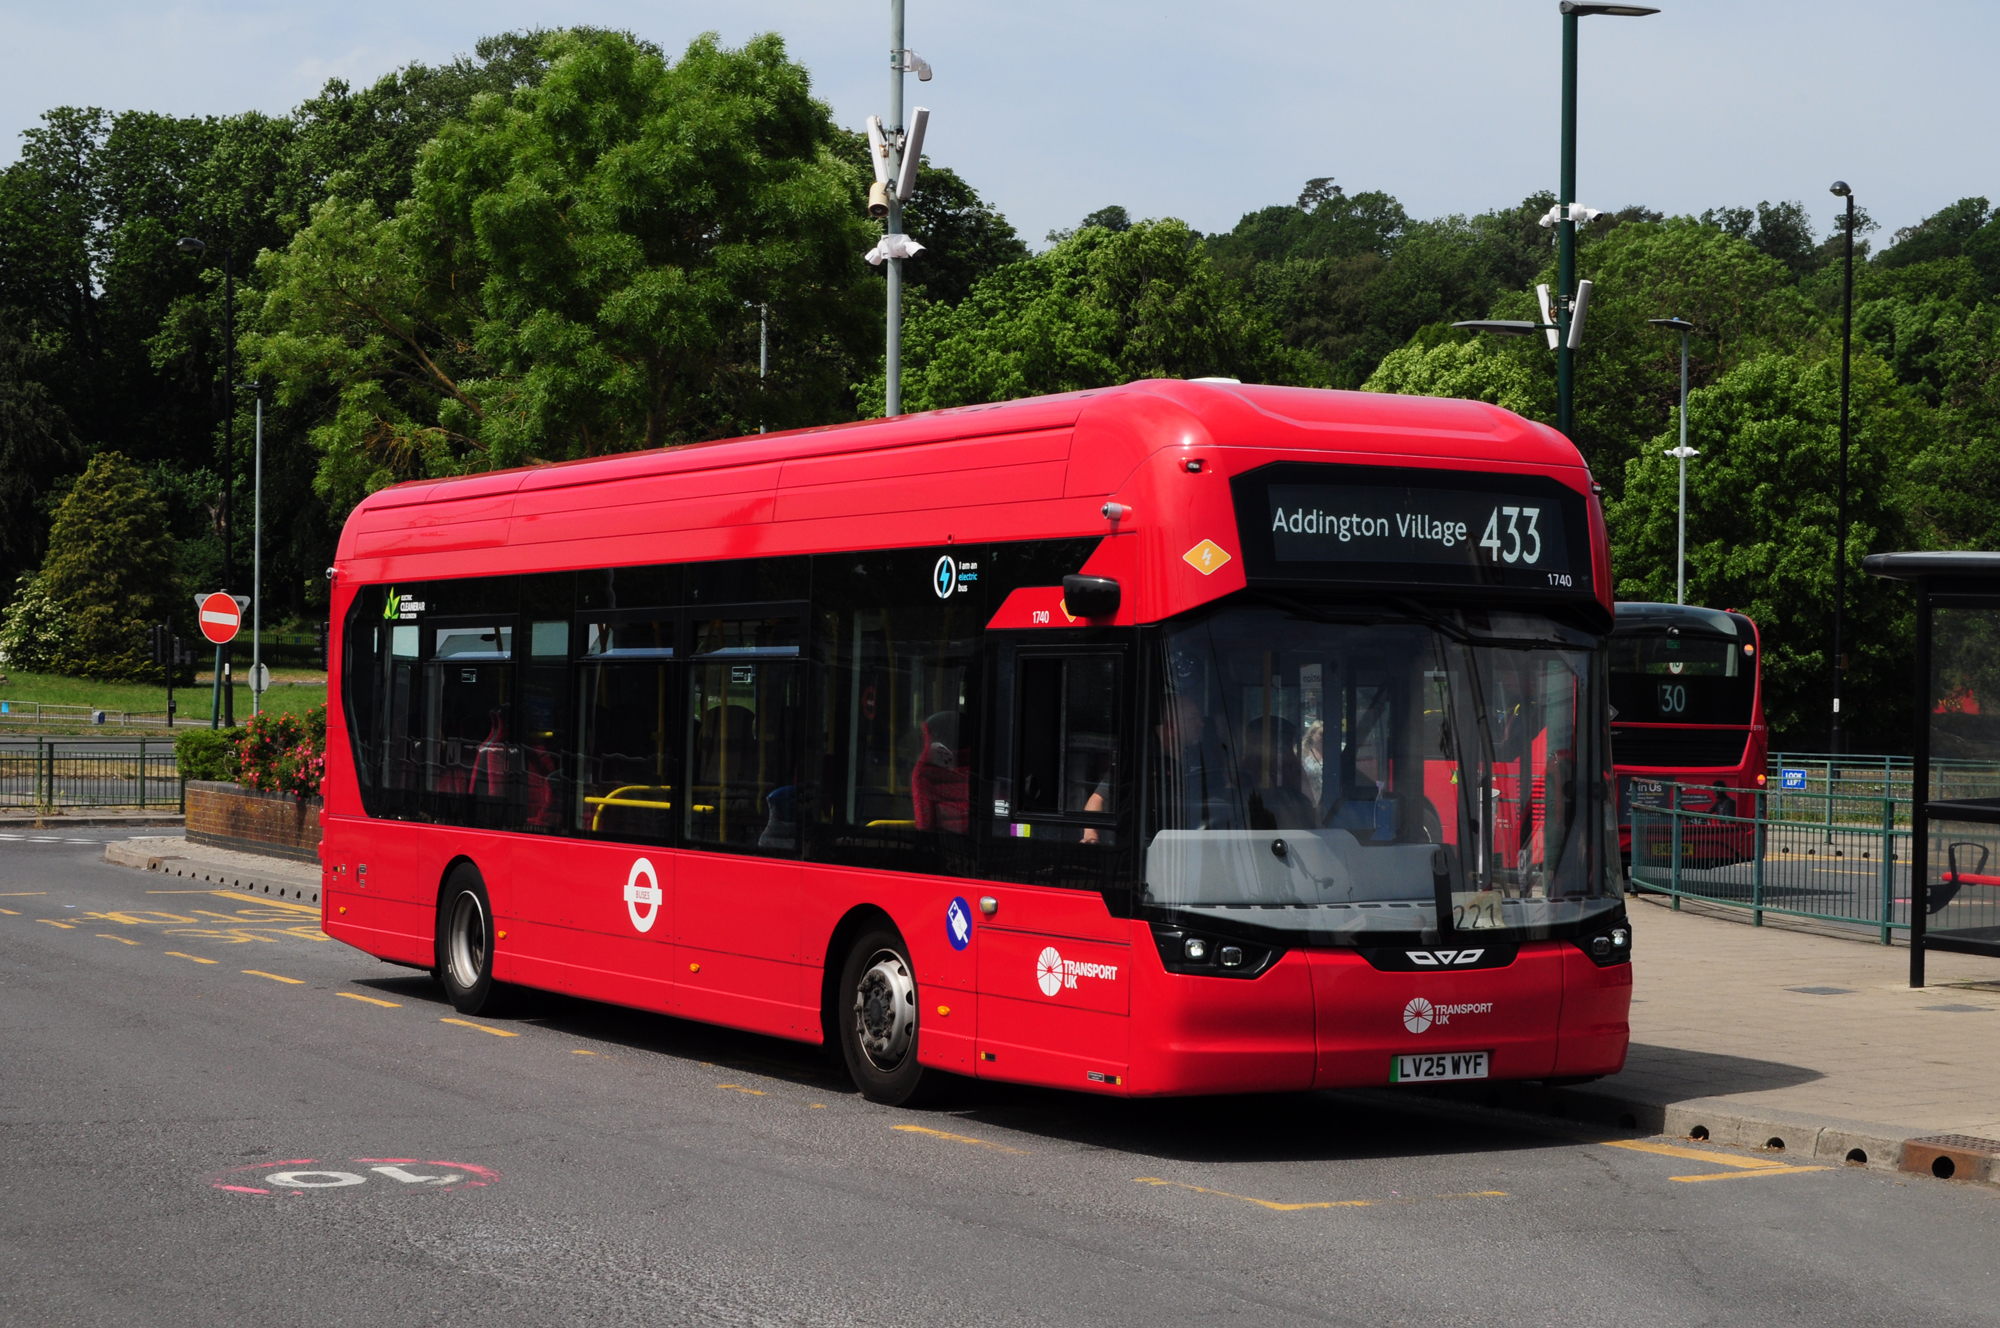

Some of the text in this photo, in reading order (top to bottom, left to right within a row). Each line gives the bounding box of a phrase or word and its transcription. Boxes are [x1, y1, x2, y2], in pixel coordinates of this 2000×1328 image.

[1272, 507, 1467, 547] Addington Village
[1479, 506, 1541, 564] 433
[962, 562, 970, 570] am
[970, 562, 978, 570] an
[958, 572, 978, 581] electric
[1547, 573, 1573, 587] 1740
[957, 584, 968, 592] bus
[1032, 610, 1050, 624] 1740
[1661, 684, 1686, 713] 30
[1628, 782, 1662, 792] Jin Us
[635, 890, 650, 900] BUSES
[1453, 903, 1500, 930] 221
[1063, 959, 1118, 981] TRANSPORT
[1064, 974, 1078, 989] UK
[1434, 1002, 1493, 1015] TRANSPORT
[1435, 1015, 1450, 1025] UK
[1399, 1054, 1484, 1079] LV25 WYF
